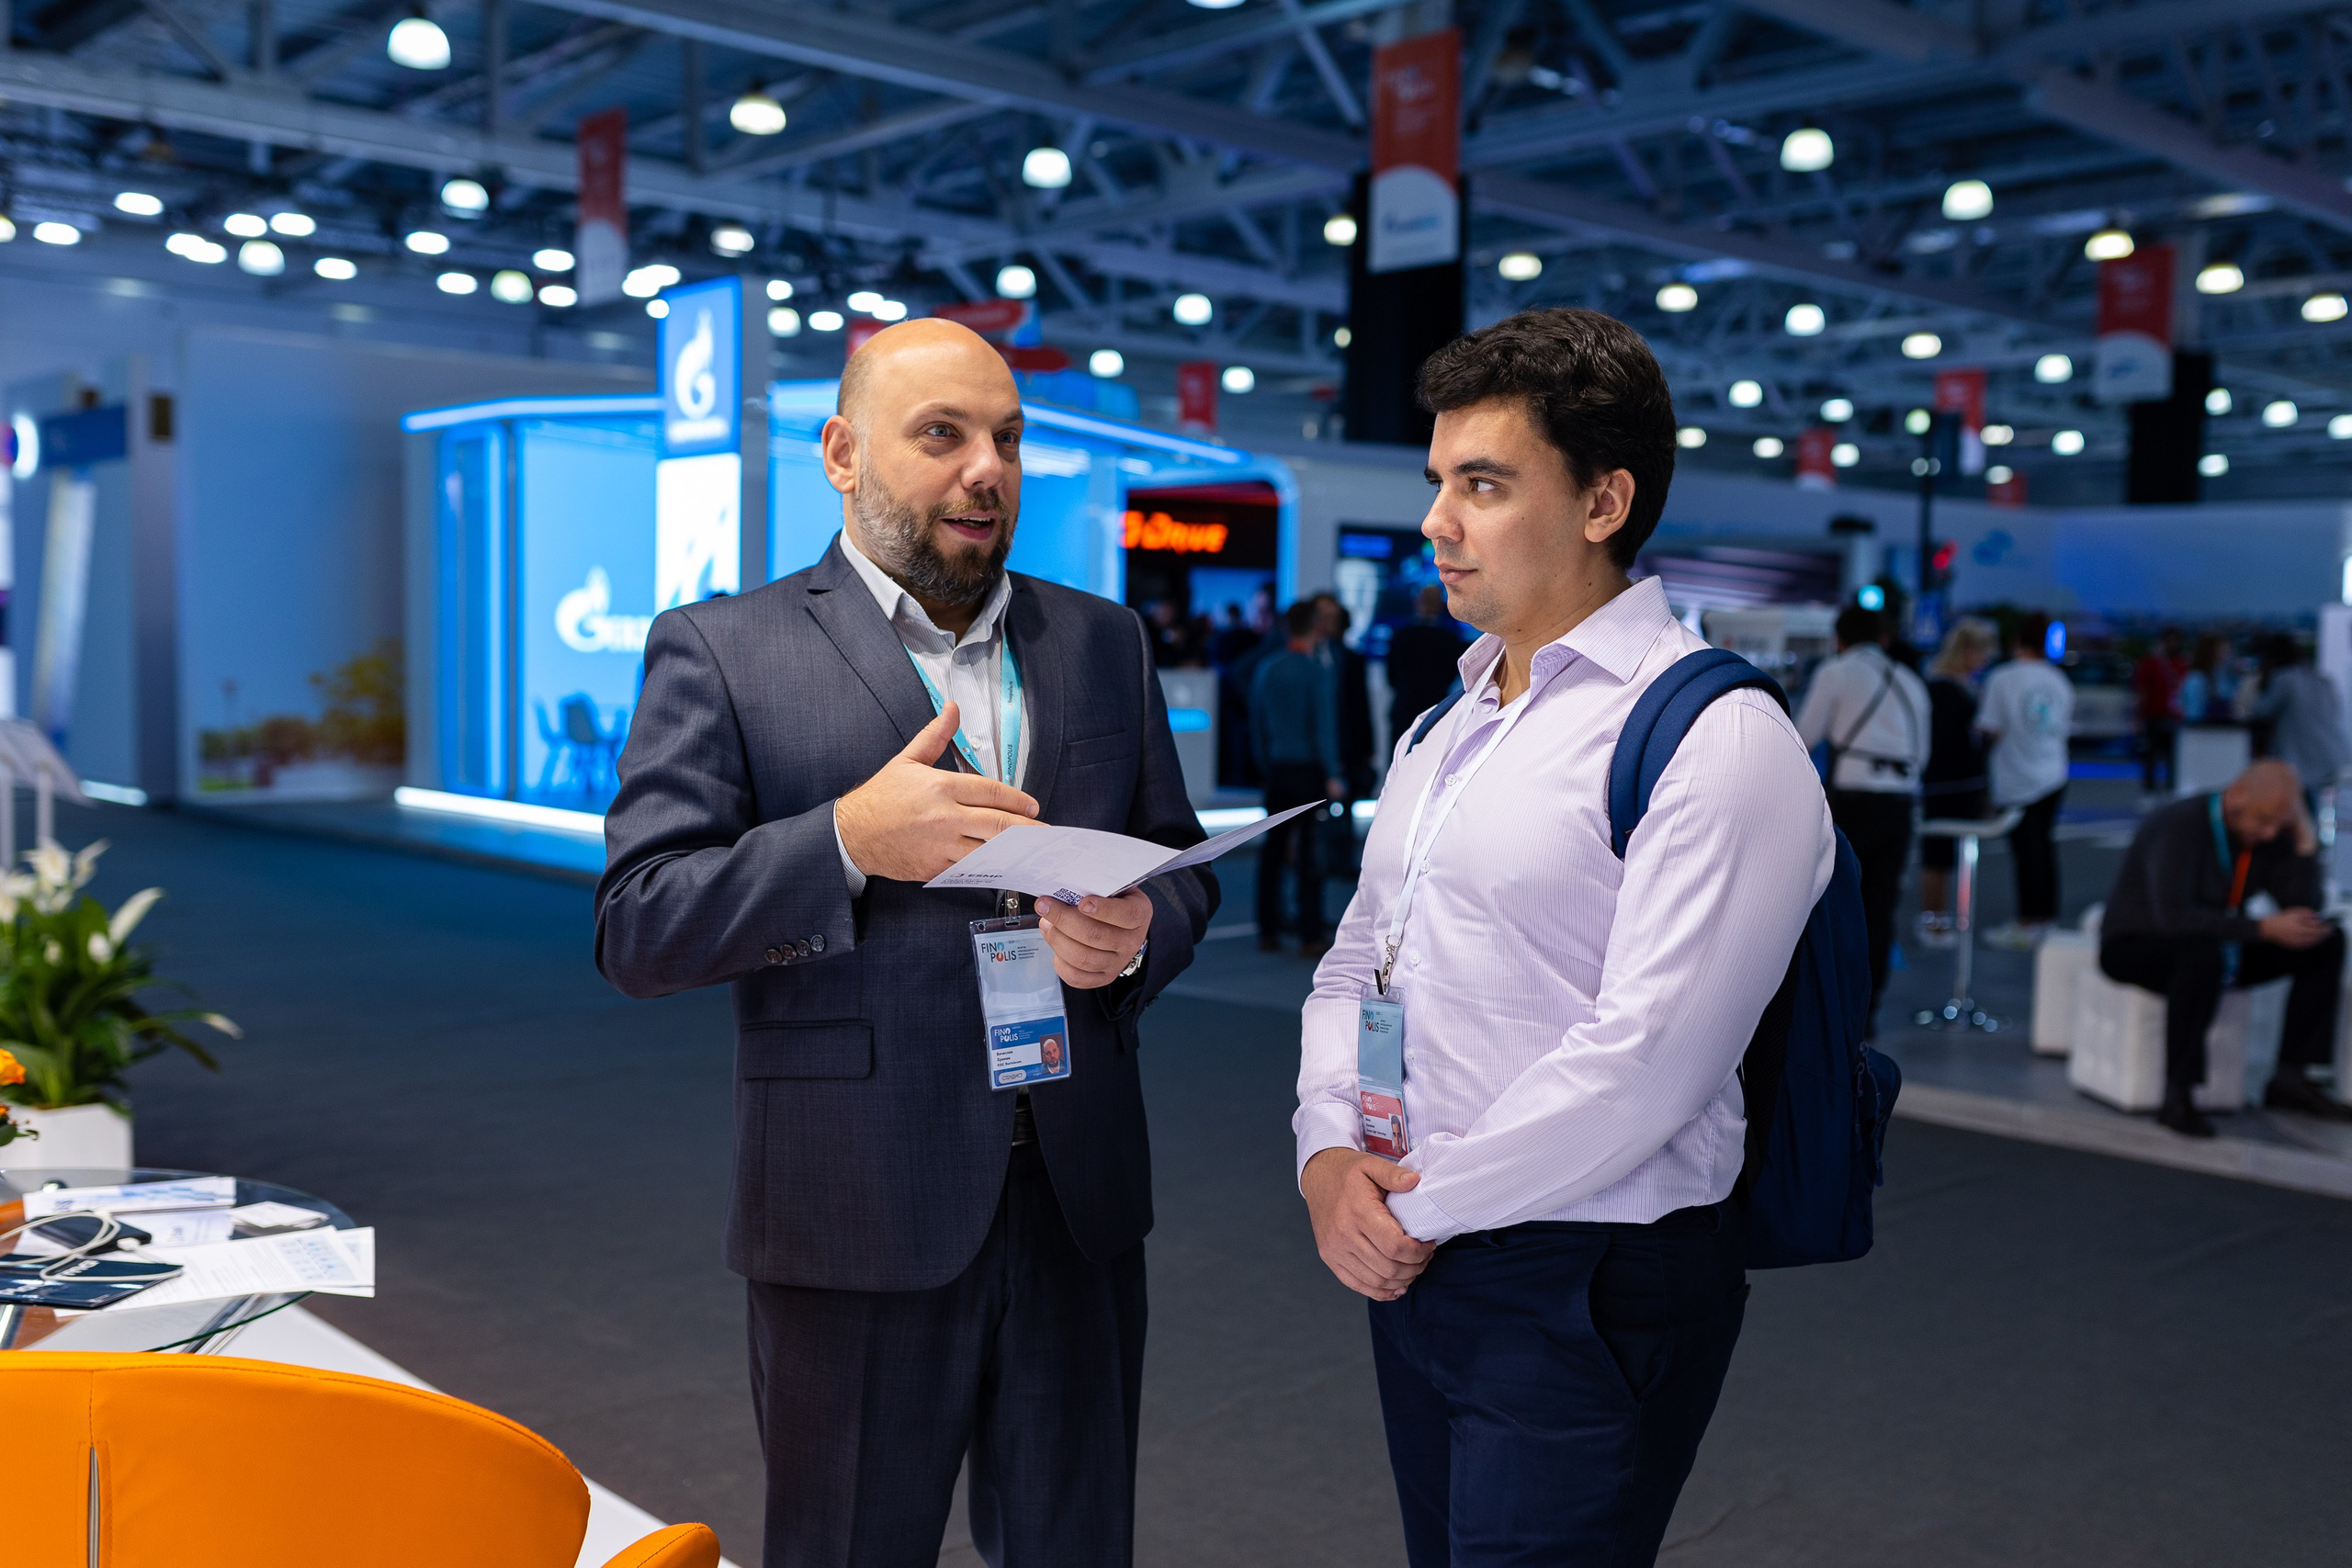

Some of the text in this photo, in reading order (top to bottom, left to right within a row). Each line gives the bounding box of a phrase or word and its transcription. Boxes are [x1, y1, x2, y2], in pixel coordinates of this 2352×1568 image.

[981, 942, 1004, 953] FINO
[990, 950, 1017, 963] POLIS
[994, 1027, 1011, 1037] FINO
[1365, 1021, 1379, 1032] POLIS
[1001, 1033, 1018, 1043] POLIS
